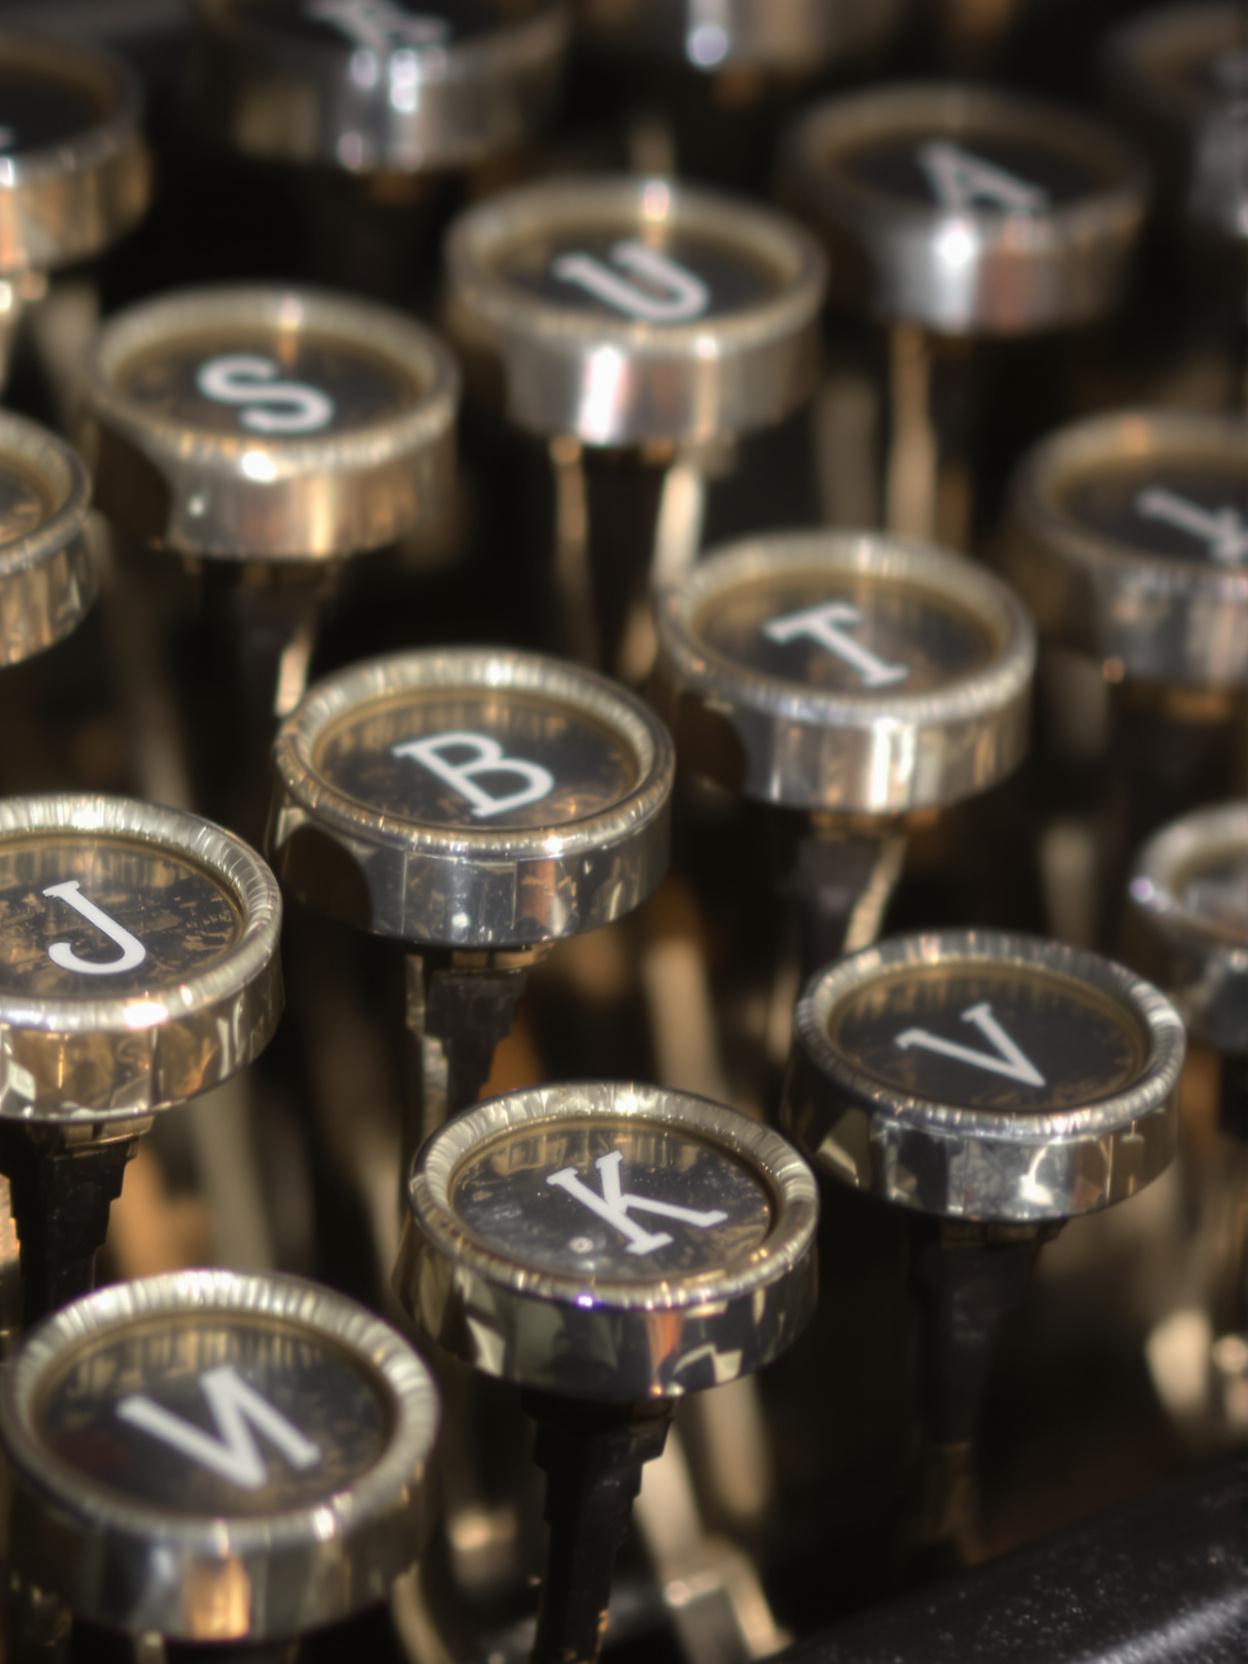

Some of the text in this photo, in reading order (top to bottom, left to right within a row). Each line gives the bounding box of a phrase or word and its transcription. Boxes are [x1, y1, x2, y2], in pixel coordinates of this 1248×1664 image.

[554, 241, 709, 322] U
[198, 354, 334, 435] S
[763, 601, 909, 689] T
[390, 729, 556, 819] B
[42, 879, 148, 976] J
[894, 1001, 1047, 1089] V
[545, 1149, 730, 1257] K
